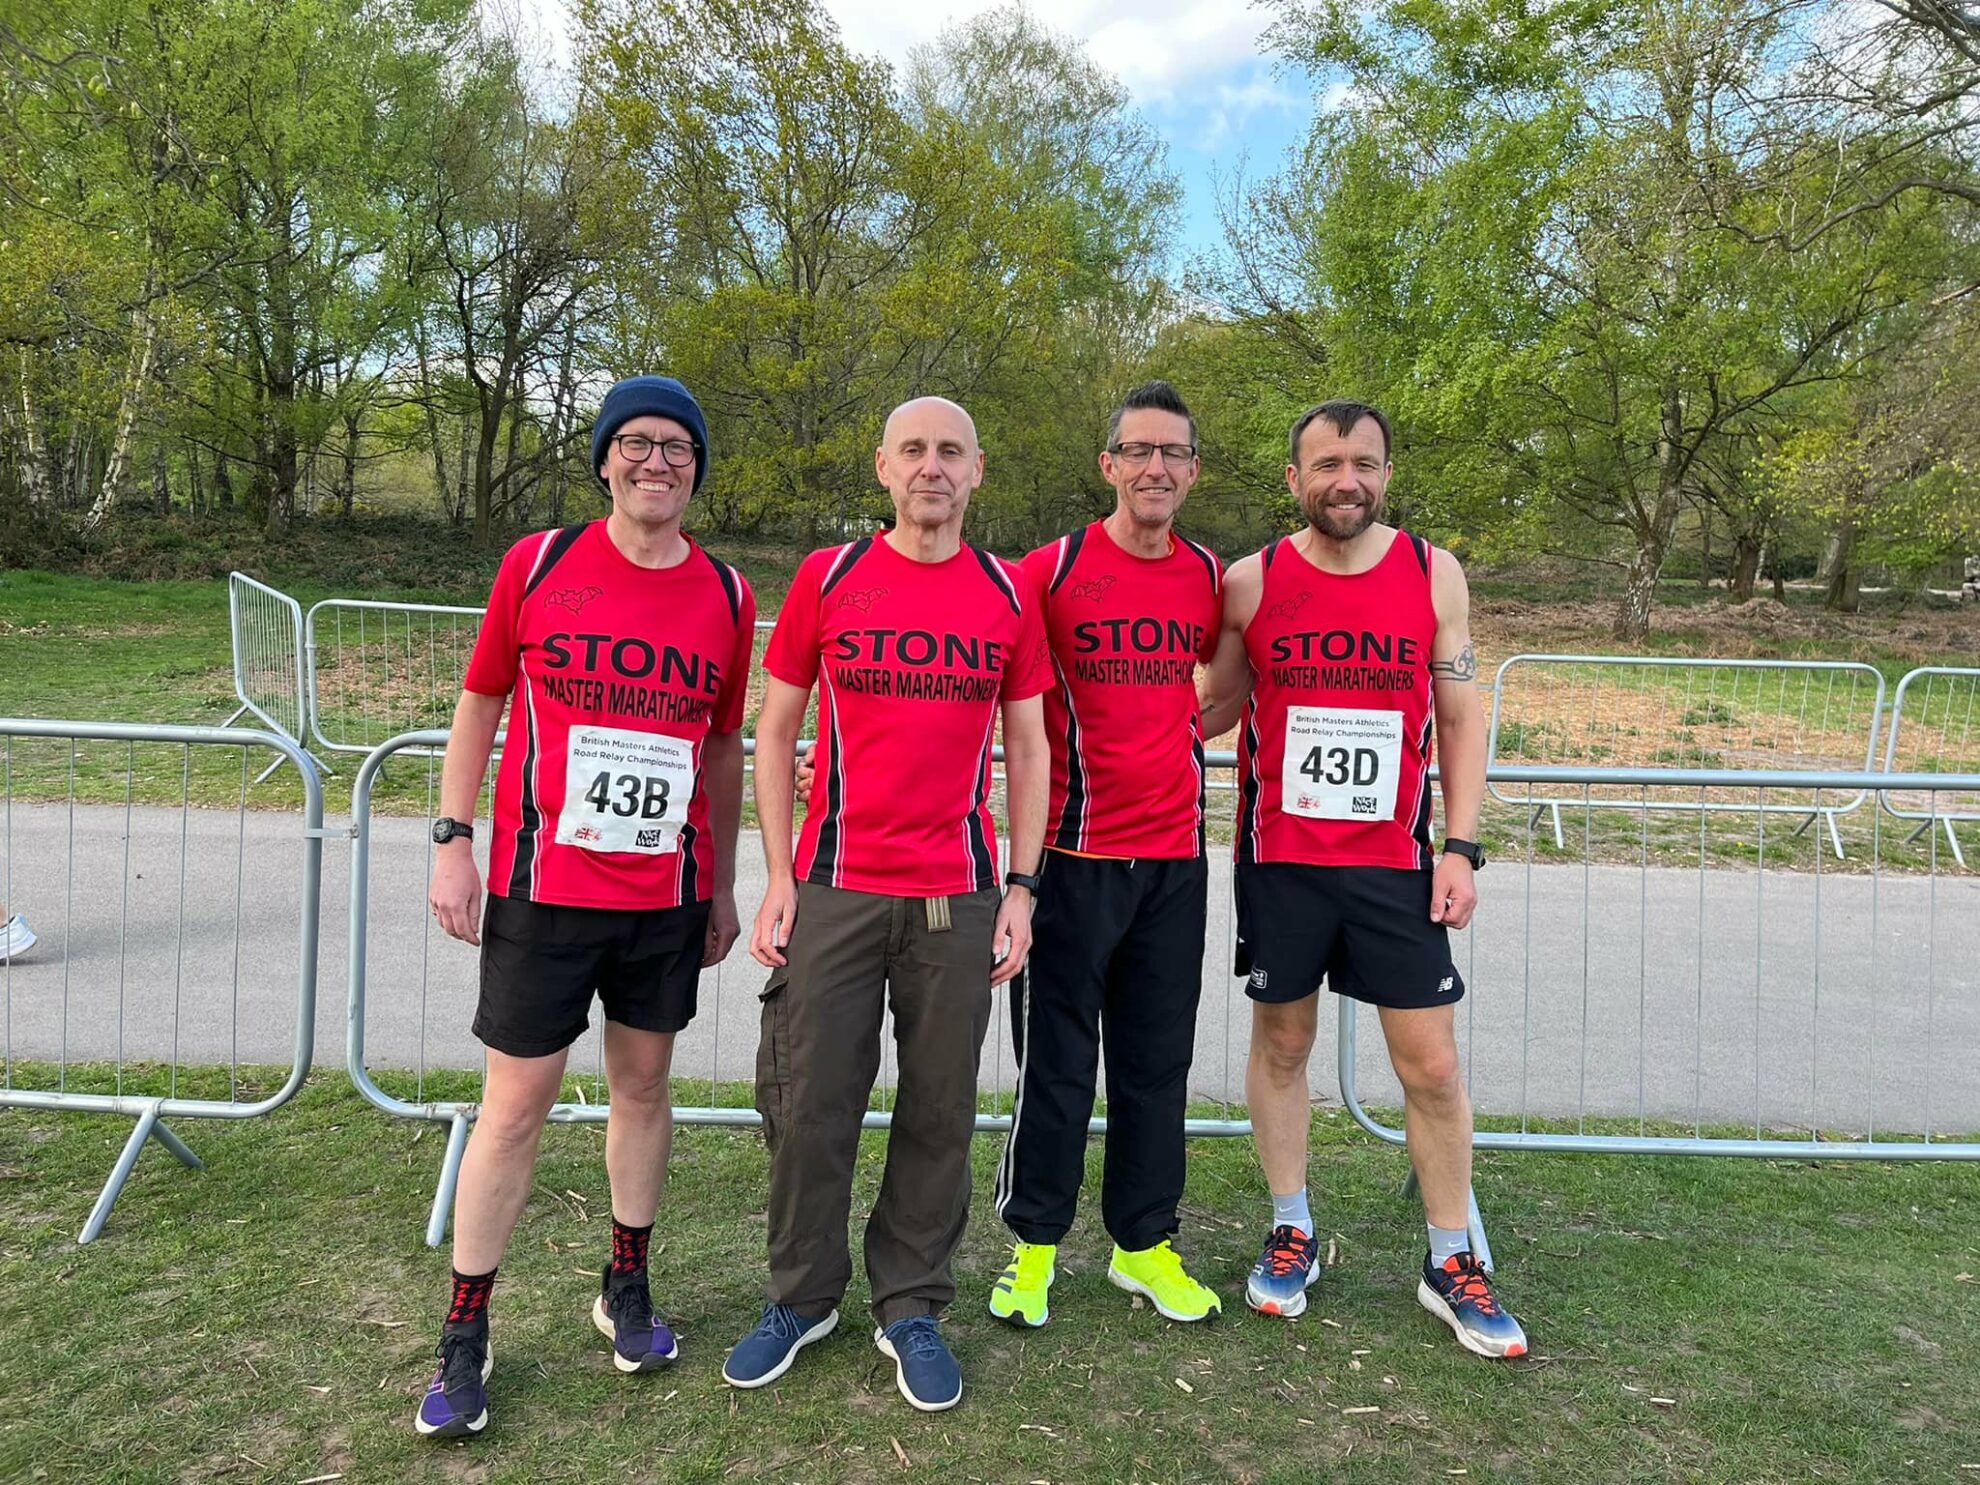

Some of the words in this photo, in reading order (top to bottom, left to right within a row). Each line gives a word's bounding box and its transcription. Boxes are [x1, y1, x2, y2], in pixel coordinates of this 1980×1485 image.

[835, 629, 1001, 672] STONE
[1073, 617, 1204, 654] STONE
[1270, 630, 1418, 665] STONE
[542, 632, 720, 695] STONE
[1075, 659, 1130, 685] MASTER
[1273, 666, 1318, 689] MASTER
[1321, 667, 1415, 691] MARATHONERS
[543, 674, 604, 713] MASTER
[835, 666, 891, 697] MASTER
[1291, 726, 1310, 735] Road
[1312, 728, 1334, 738] Relay
[1336, 729, 1396, 739] Championships
[1296, 715, 1320, 724] British
[1322, 717, 1353, 726] Masters
[1355, 719, 1390, 727] Athletics
[573, 748, 598, 758] Road
[600, 751, 625, 763] Relay
[627, 754, 687, 770] Championships
[581, 736, 610, 747] British
[612, 739, 646, 751] Masters
[649, 744, 680, 757] Athletics
[1299, 745, 1380, 786] 43D
[584, 770, 671, 820] 43B
